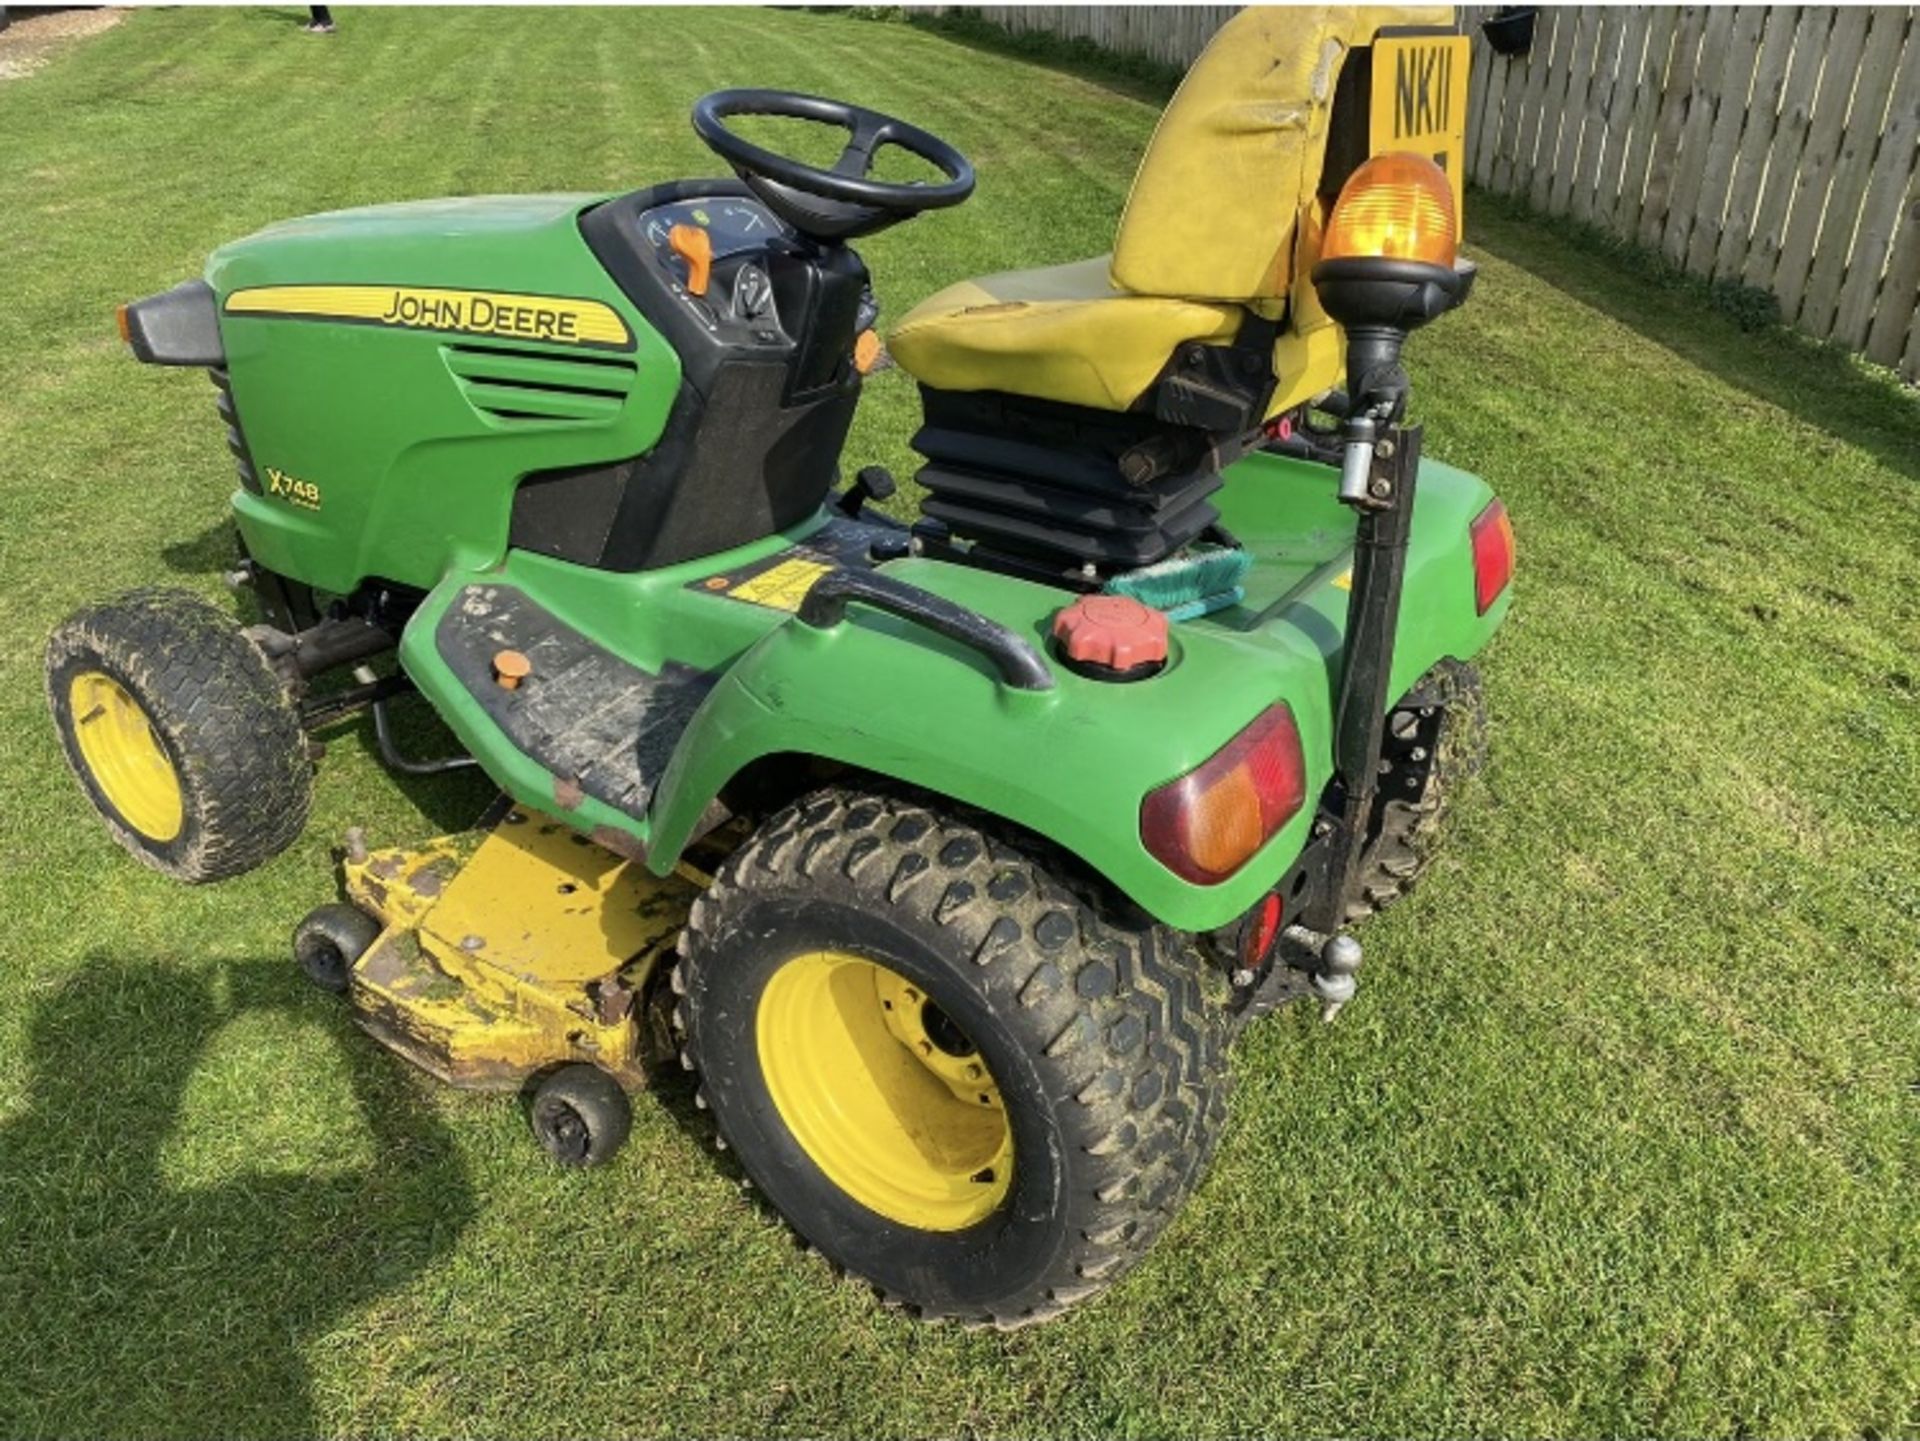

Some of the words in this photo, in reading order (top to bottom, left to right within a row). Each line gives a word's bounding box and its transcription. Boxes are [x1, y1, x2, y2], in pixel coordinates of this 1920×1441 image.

[383, 291, 462, 326] JOHN
[470, 298, 577, 338] DEERE
[265, 467, 319, 501] X748
